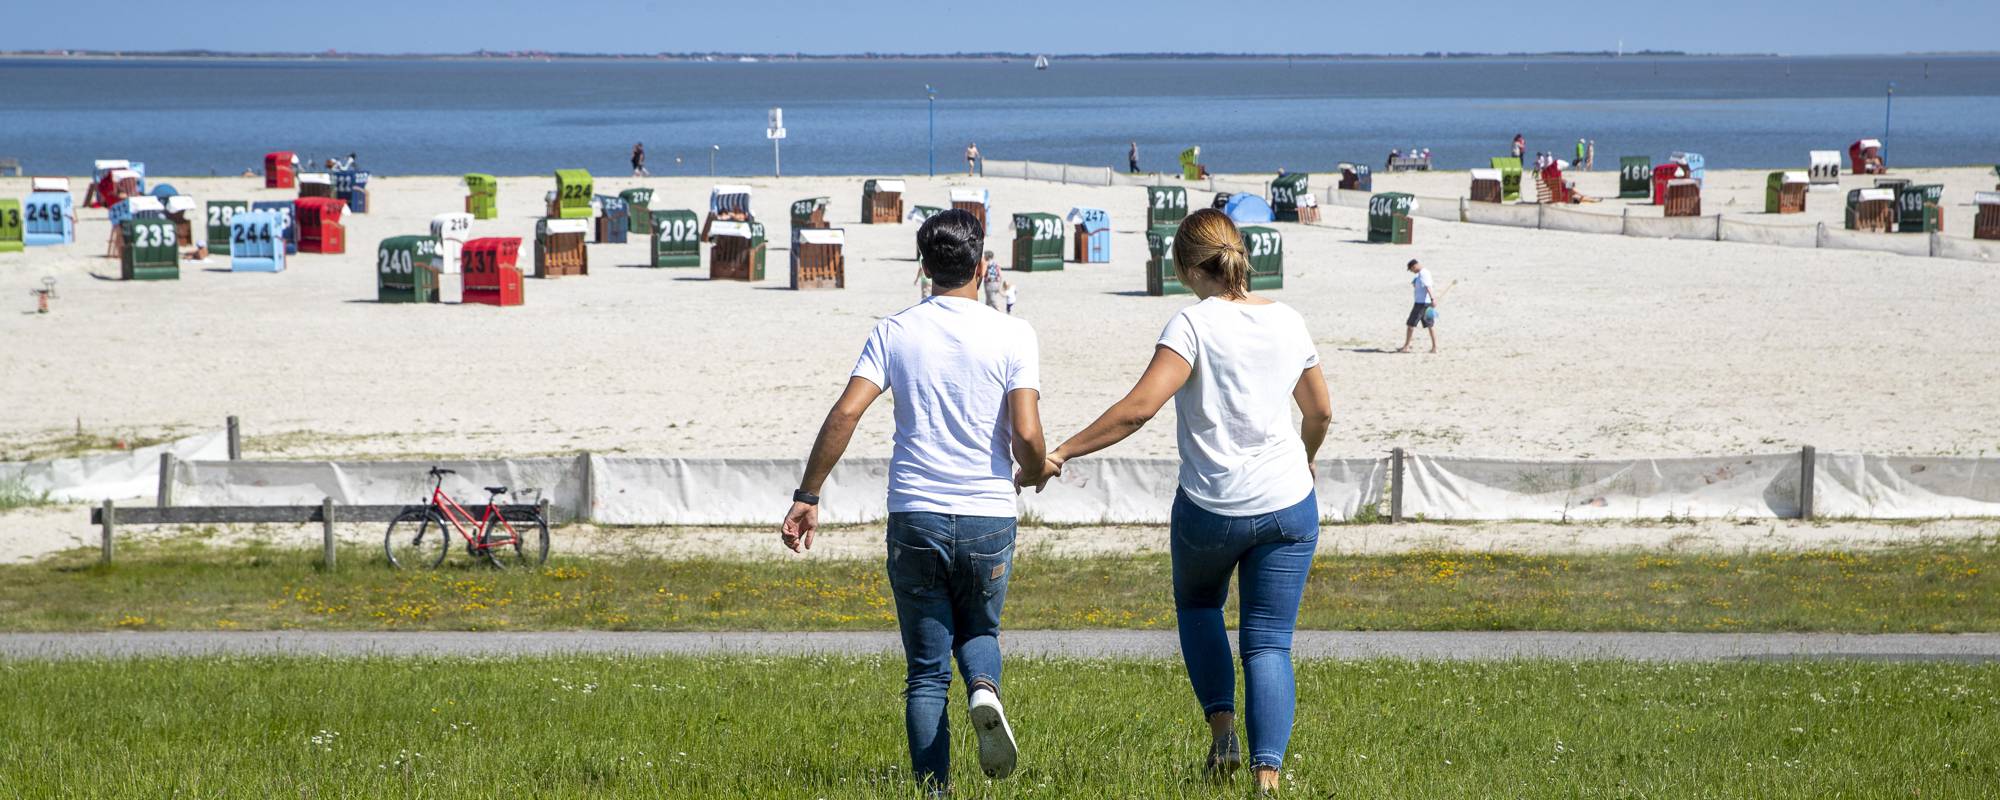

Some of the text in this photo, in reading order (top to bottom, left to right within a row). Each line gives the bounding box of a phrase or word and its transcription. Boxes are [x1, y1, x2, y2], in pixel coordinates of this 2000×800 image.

[1623, 166, 1648, 180] 160
[1813, 165, 1839, 178] 116
[565, 185, 592, 200] 224
[1155, 191, 1186, 209] 214
[1272, 188, 1294, 204] 231
[1901, 193, 1922, 211] 199
[27, 203, 61, 222] 249
[1370, 196, 1392, 216] 204
[451, 219, 469, 231] 216
[1085, 211, 1105, 222] 247
[135, 224, 176, 248] 235
[234, 224, 272, 244] 244
[660, 220, 698, 242] 202
[1034, 218, 1062, 240] 294
[1252, 232, 1281, 256] 257
[379, 249, 413, 274] 240
[463, 250, 498, 274] 237
